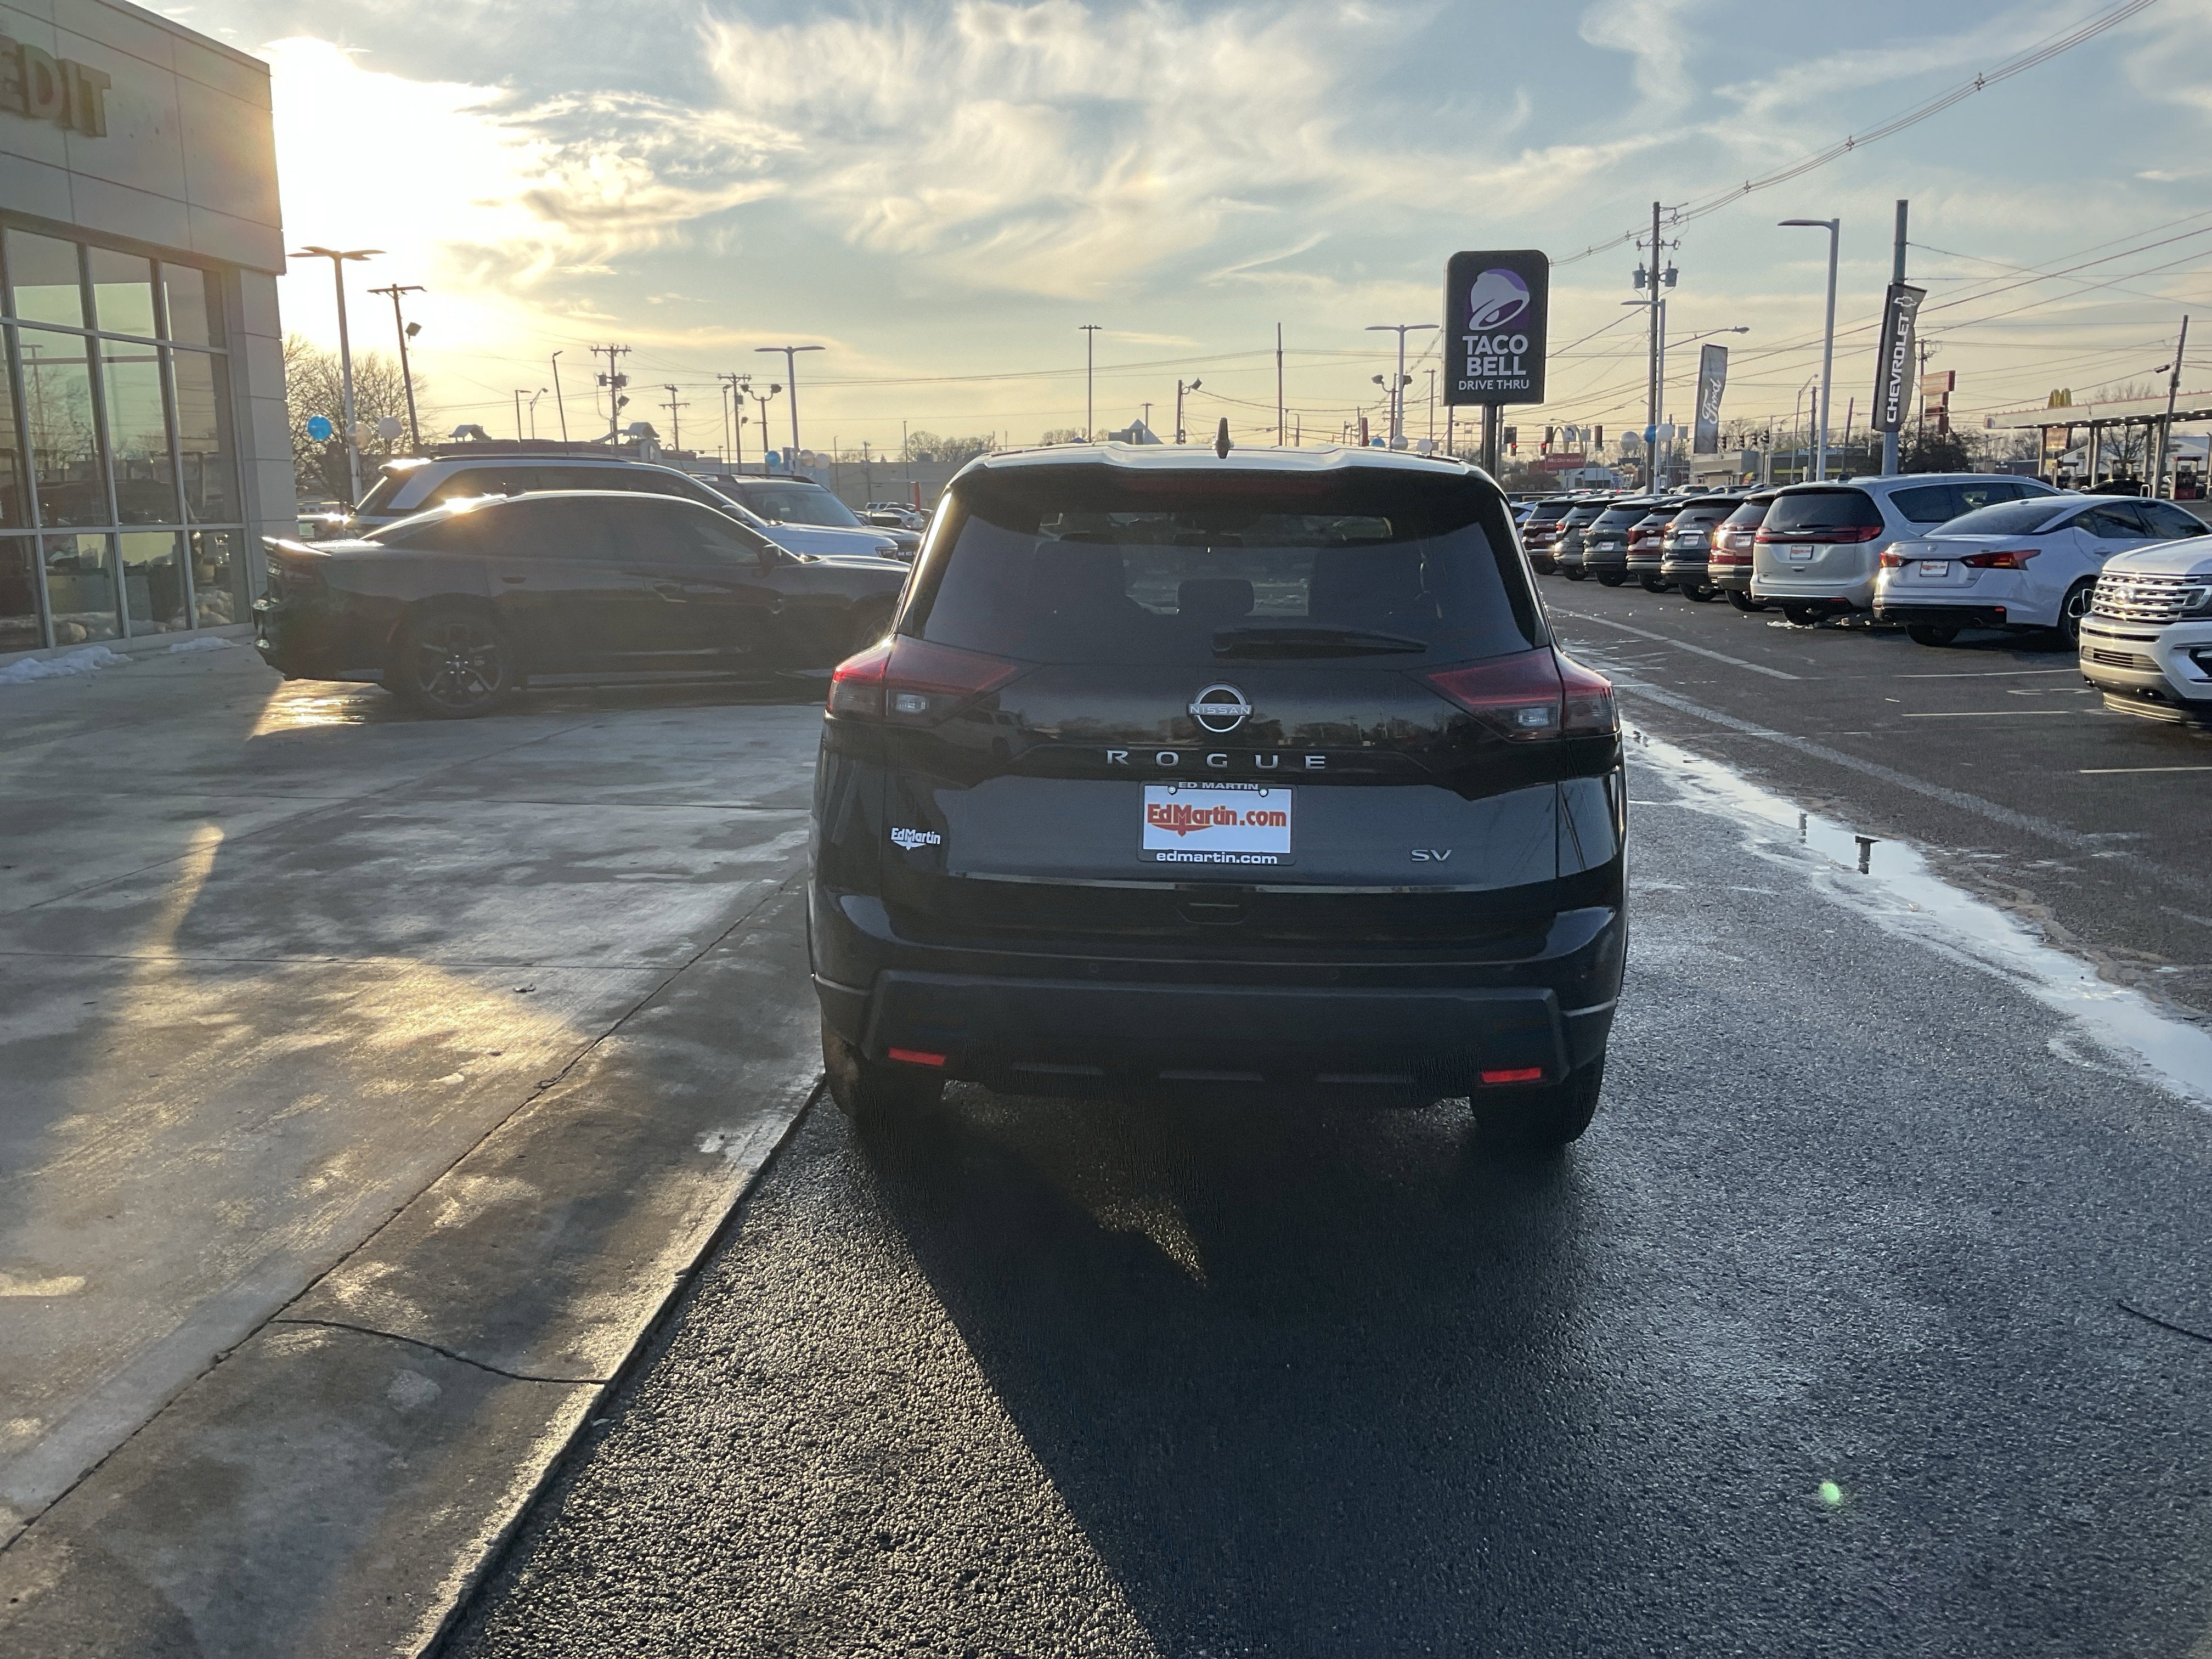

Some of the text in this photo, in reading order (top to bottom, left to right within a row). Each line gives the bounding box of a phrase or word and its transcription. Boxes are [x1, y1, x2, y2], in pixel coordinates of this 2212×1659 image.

[1462, 334, 1528, 356] TACO
[1466, 356, 1526, 376] BELL
[1886, 312, 1910, 422] CHEVROLET
[1458, 379, 1530, 390] DRIVE THRU
[1702, 377, 1722, 425] Ford
[1189, 704, 1251, 715] NISSAN
[1106, 749, 1327, 770] ROGUE
[890, 827, 941, 845] EdMartin
[1156, 850, 1277, 865] edmartin.com
[1411, 849, 1452, 861] SV
